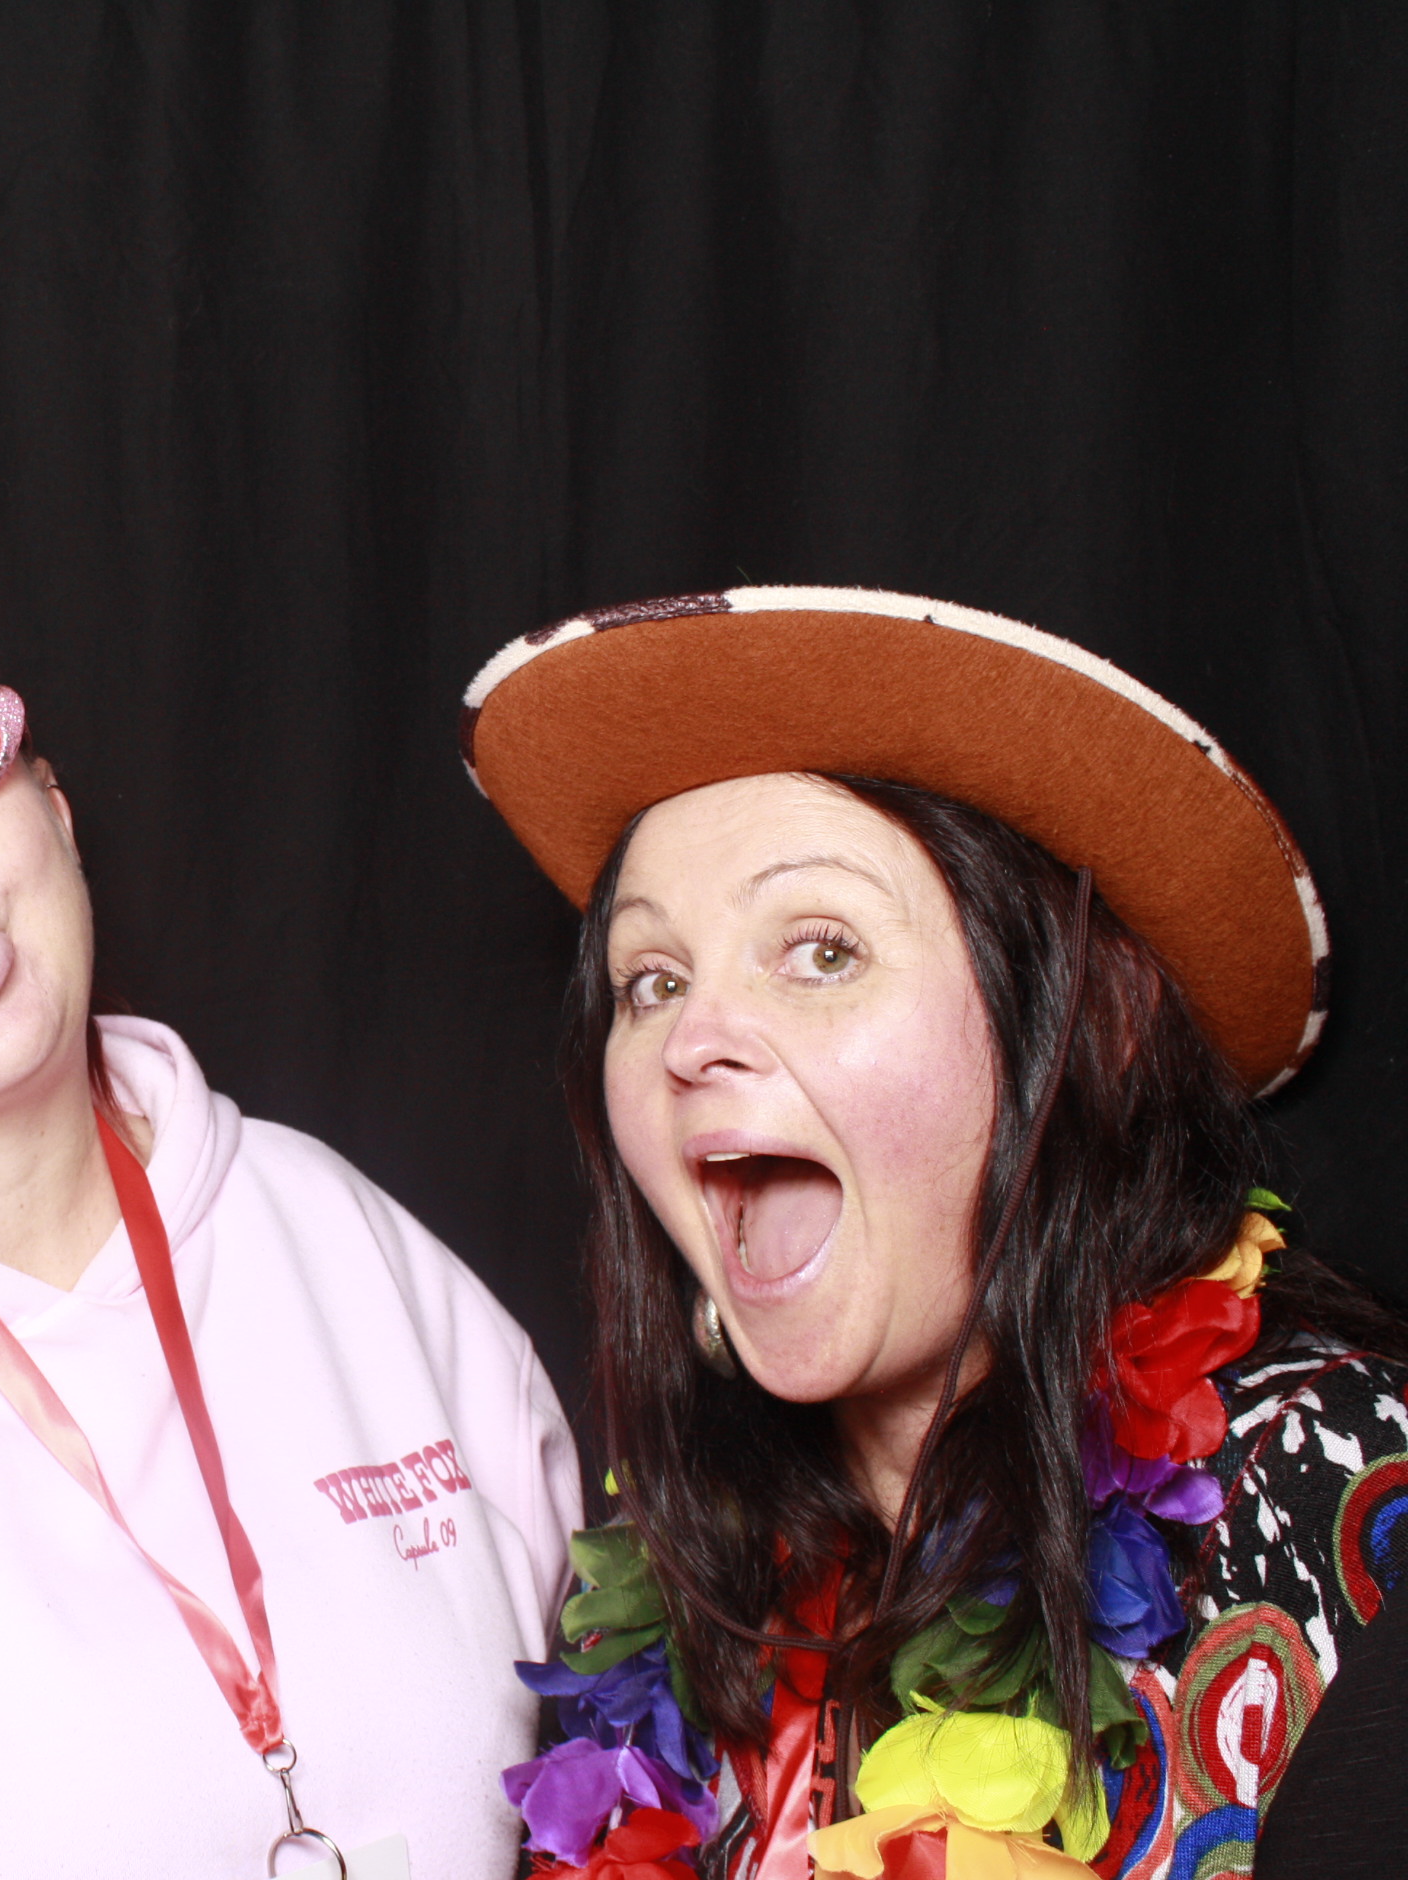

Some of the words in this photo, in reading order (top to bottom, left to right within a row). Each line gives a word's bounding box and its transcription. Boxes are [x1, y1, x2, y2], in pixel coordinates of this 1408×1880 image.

[313, 1462, 424, 1525] WHITE
[400, 1439, 472, 1503] FOX
[393, 1516, 440, 1571] Capsule
[440, 1517, 457, 1548] 09
